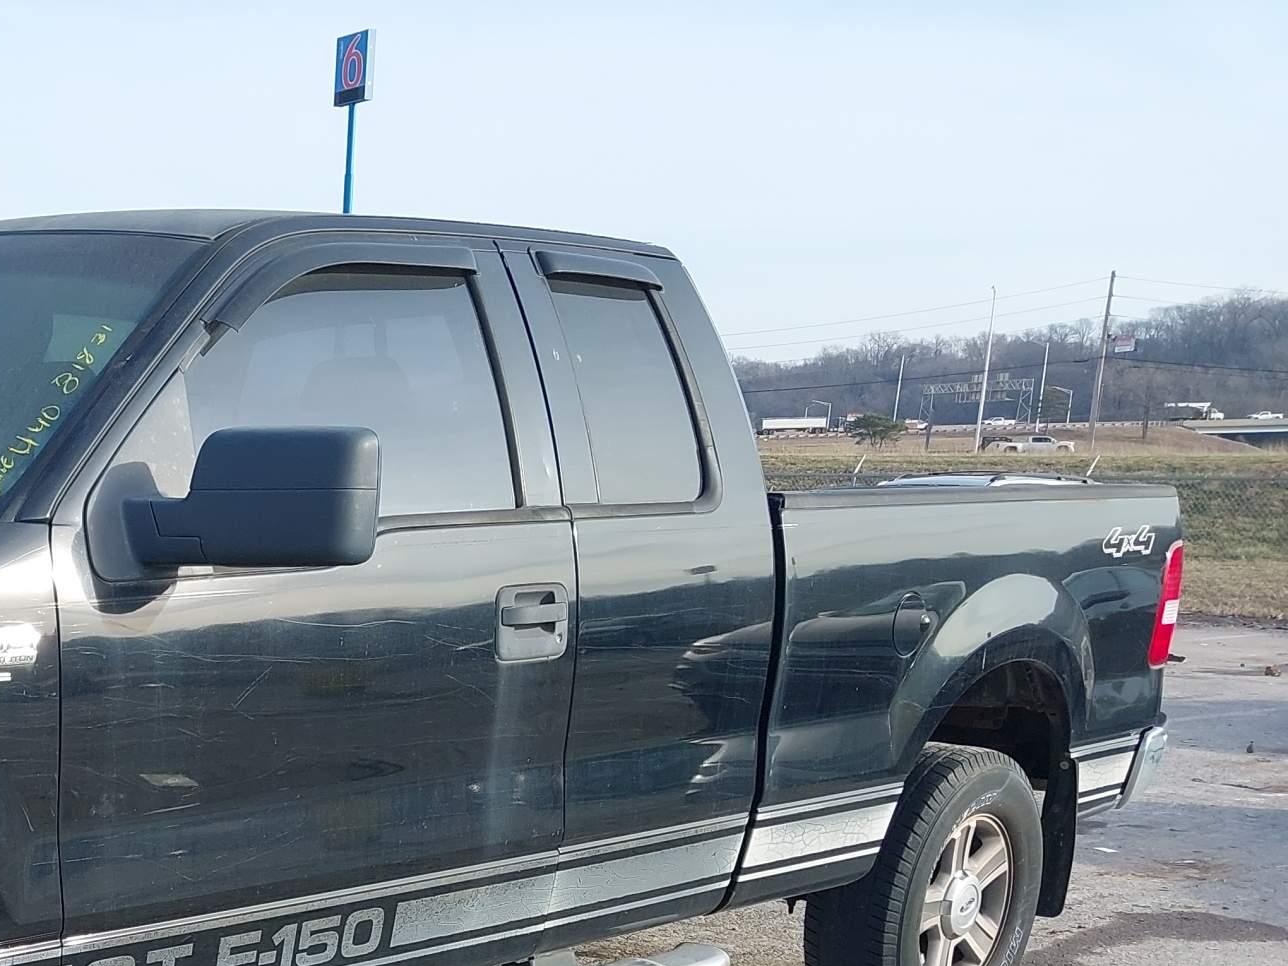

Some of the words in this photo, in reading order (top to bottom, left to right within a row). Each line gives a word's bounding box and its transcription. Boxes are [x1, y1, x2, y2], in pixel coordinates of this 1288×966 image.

[341, 33, 362, 89] 6
[8, 405, 61, 454] 440
[1103, 525, 1155, 558] 4x4
